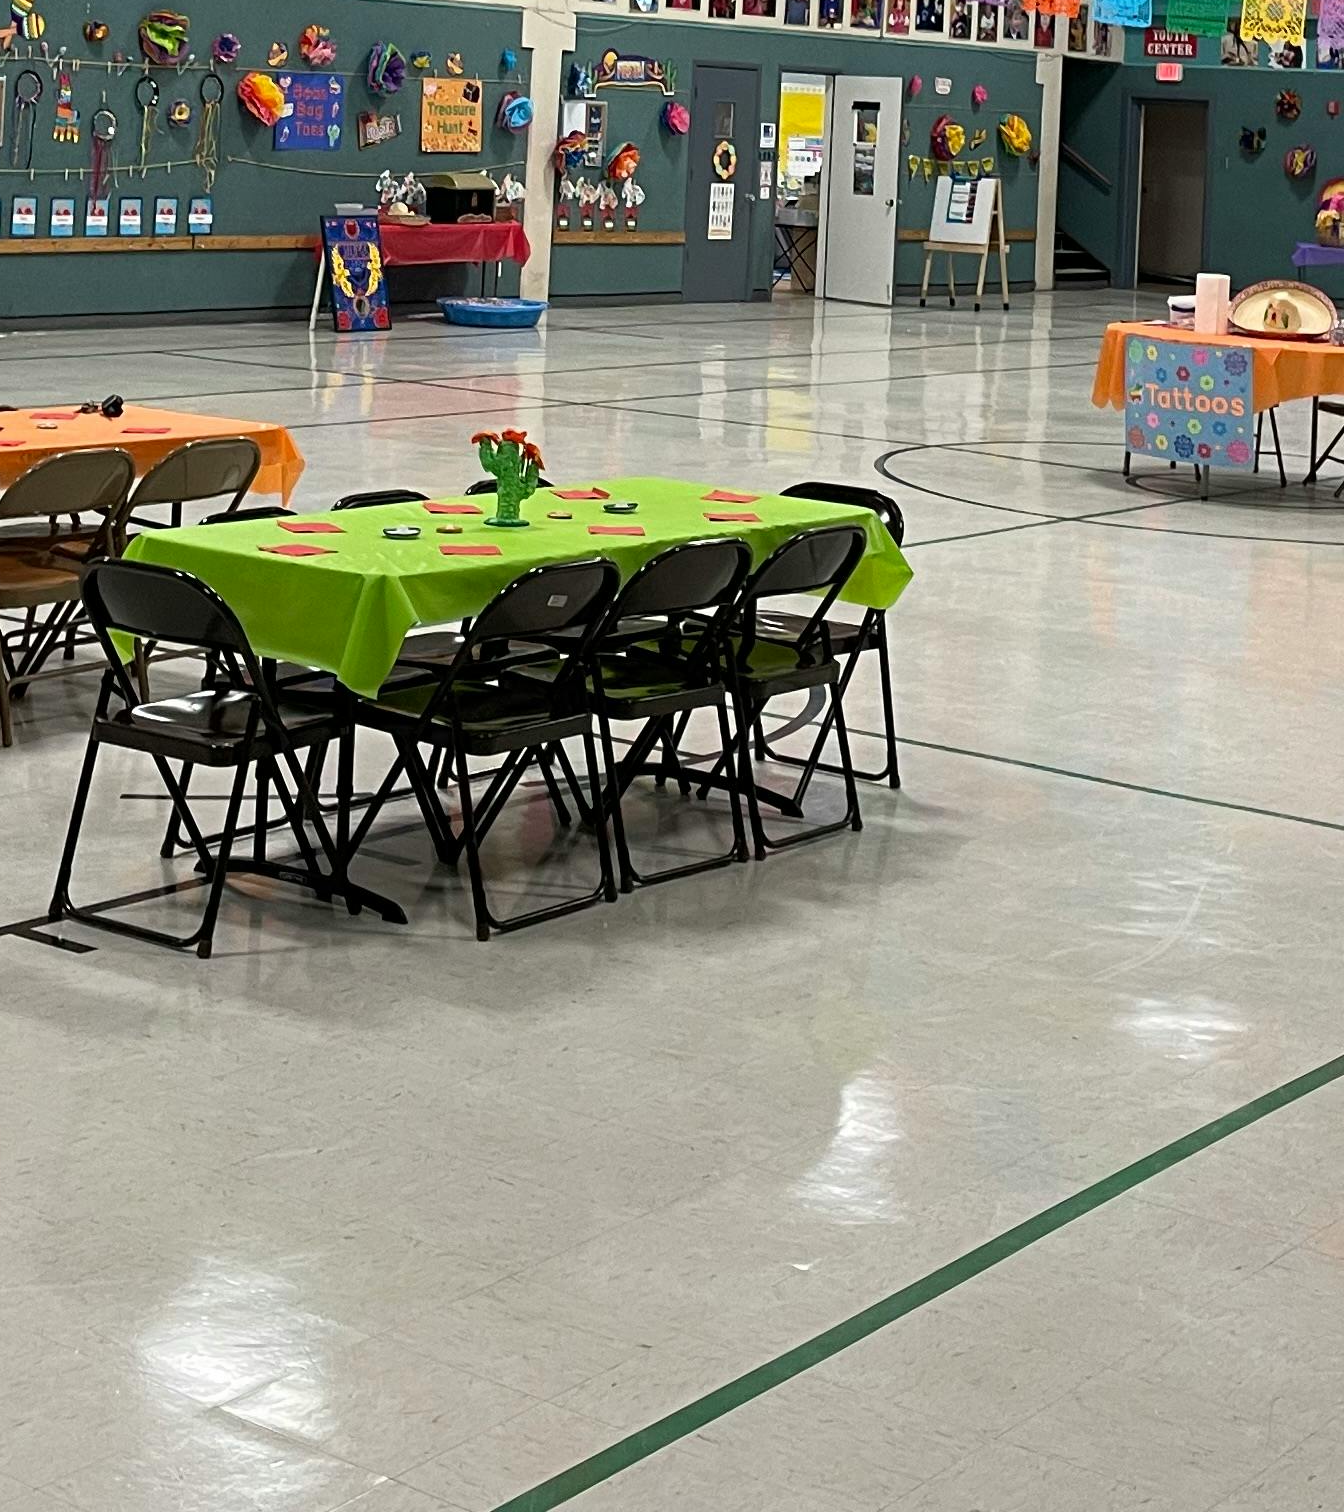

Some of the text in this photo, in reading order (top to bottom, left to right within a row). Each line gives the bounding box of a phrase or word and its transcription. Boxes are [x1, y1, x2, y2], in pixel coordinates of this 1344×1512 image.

[1147, 42, 1193, 56] CENTER
[296, 101, 324, 120] Bag
[427, 102, 476, 116] Treasure
[437, 120, 463, 134] Hunt
[1144, 382, 1245, 417] Tattoos
